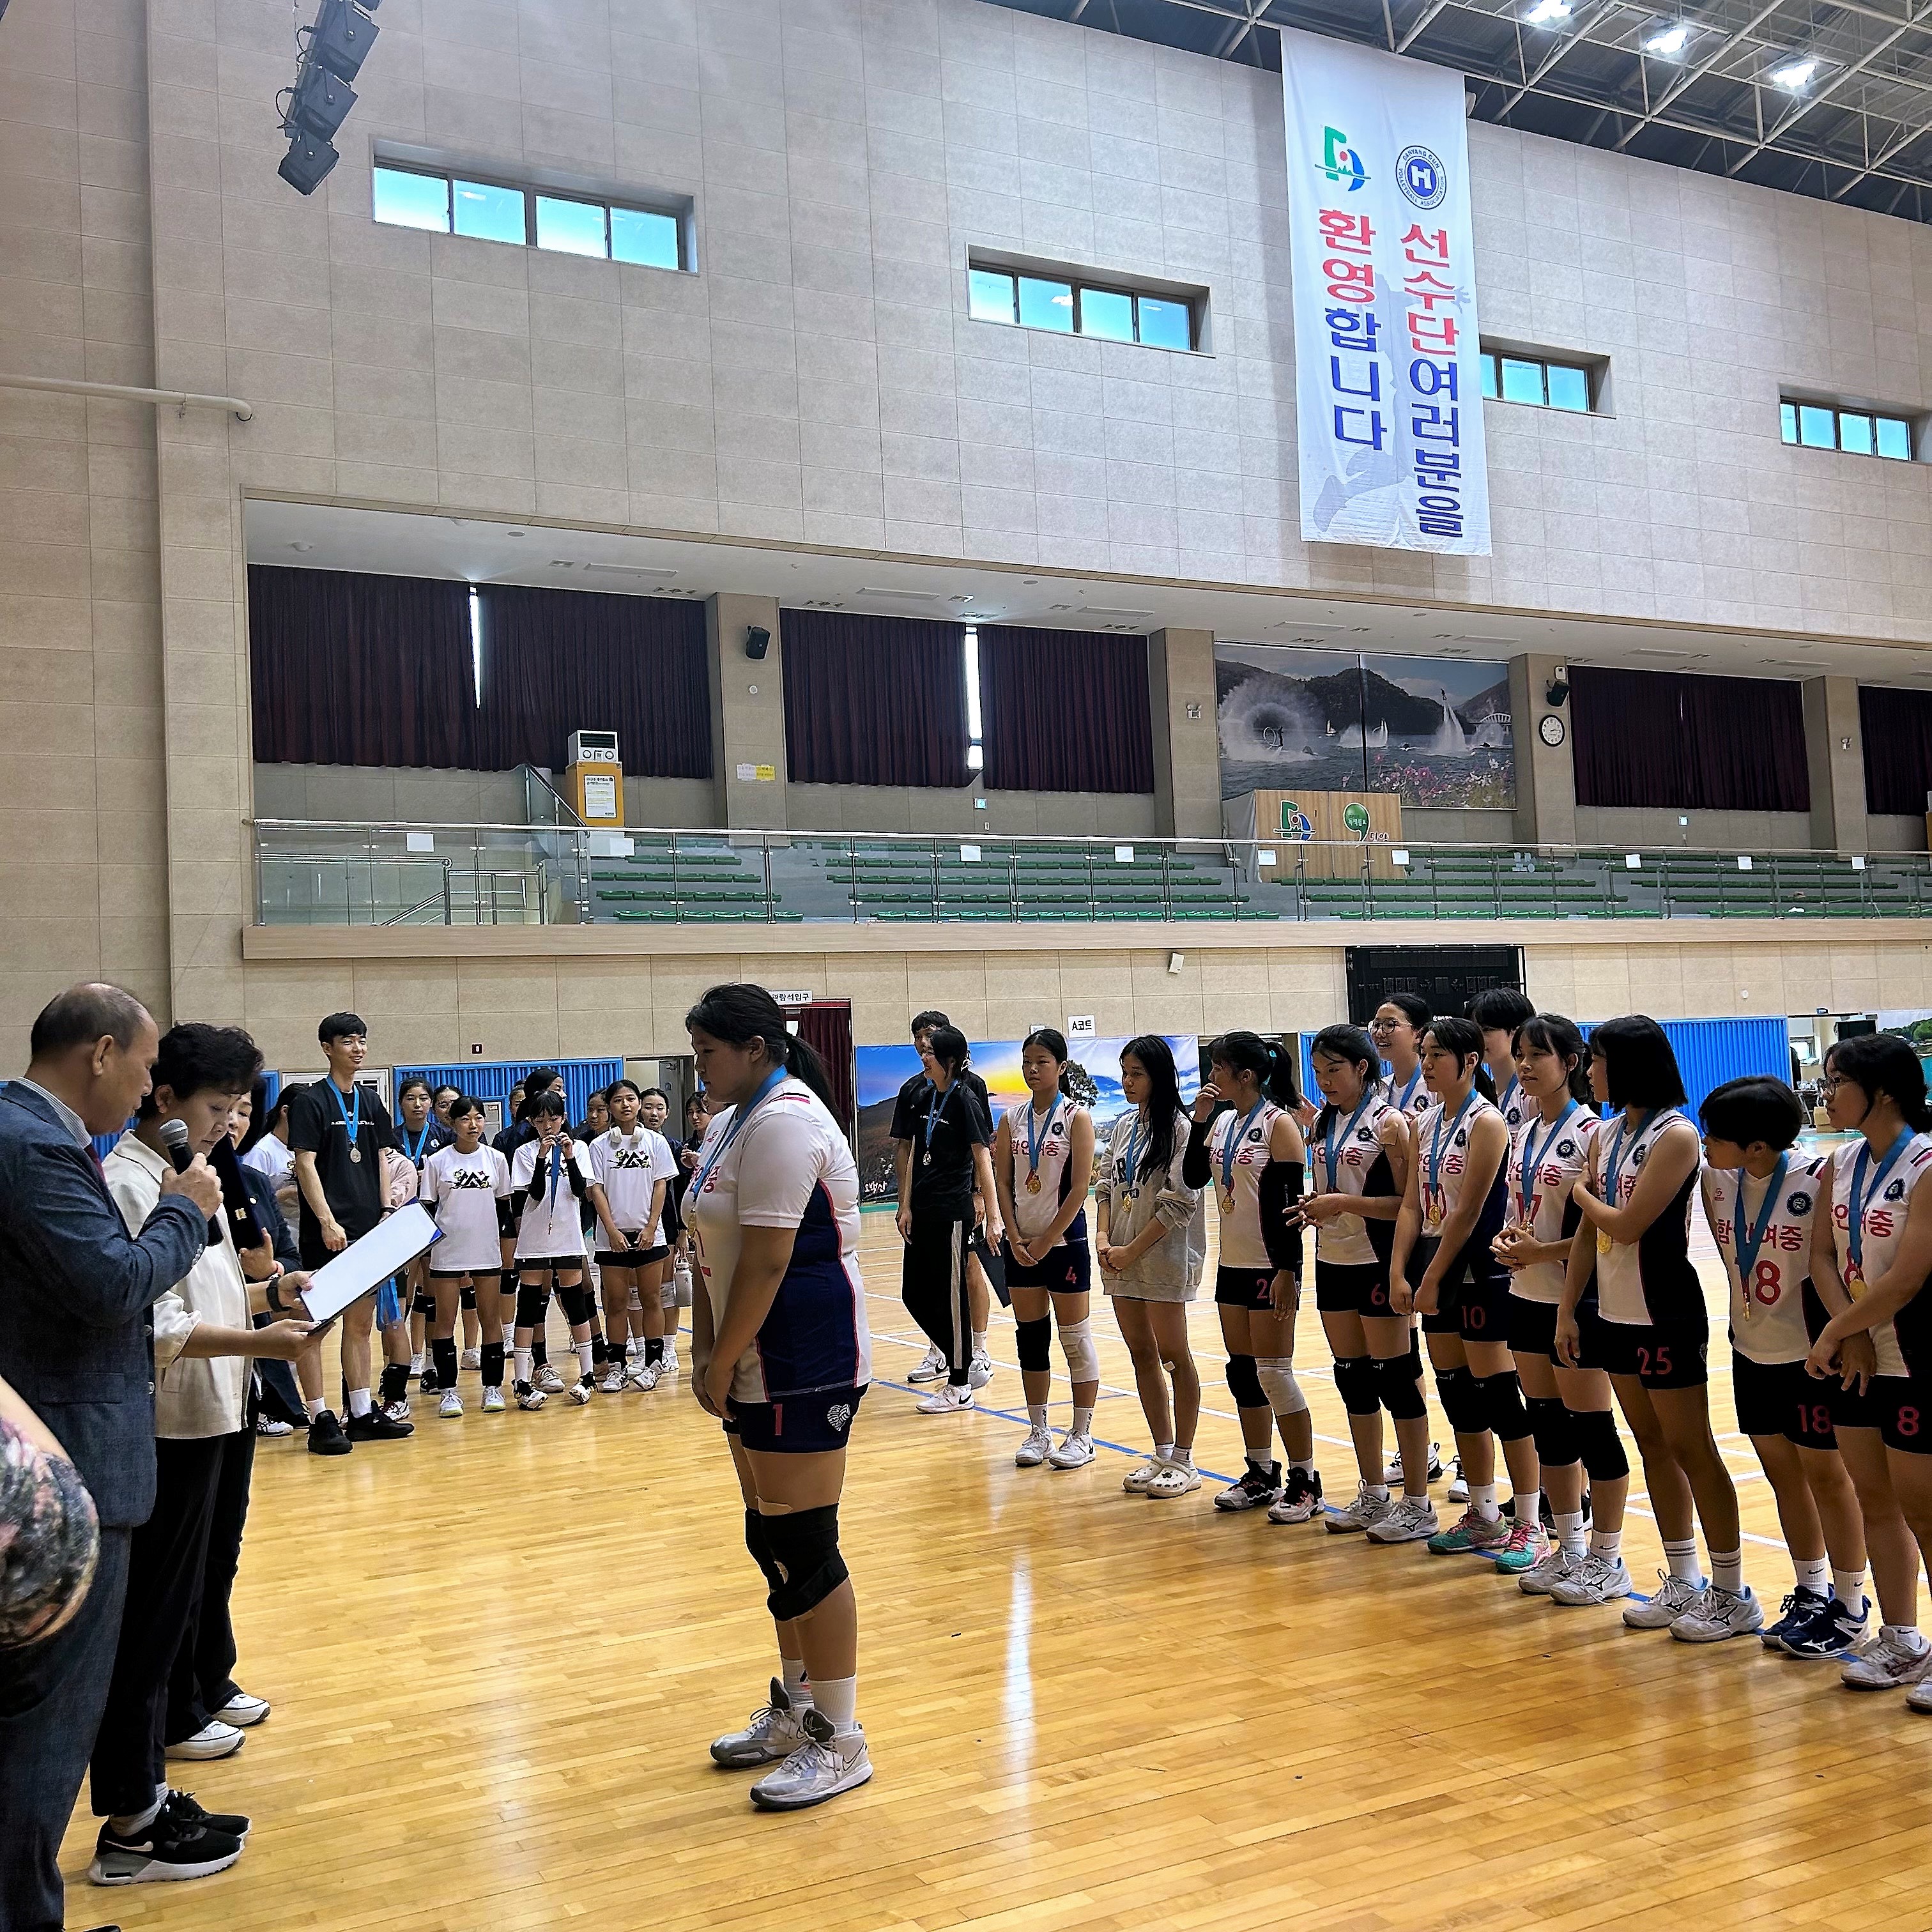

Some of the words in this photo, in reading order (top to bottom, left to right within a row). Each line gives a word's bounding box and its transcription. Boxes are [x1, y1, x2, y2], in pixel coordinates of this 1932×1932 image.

[1428, 154, 1440, 169] GUN
[1411, 165, 1432, 190] H
[1400, 224, 1459, 356] 선수단
[1319, 209, 1387, 451] 환영합니다
[1409, 358, 1464, 538] 여러분을
[1071, 1020, 1092, 1031] A코트
[1065, 1266, 1077, 1284] 4
[1256, 1278, 1268, 1299] 2
[1371, 1284, 1385, 1305] 6
[1462, 1305, 1485, 1329] 10
[1637, 1347, 1672, 1374] 25
[773, 1404, 783, 1436] 1
[1798, 1405, 1832, 1433] 18
[1897, 1406, 1919, 1436] 8
